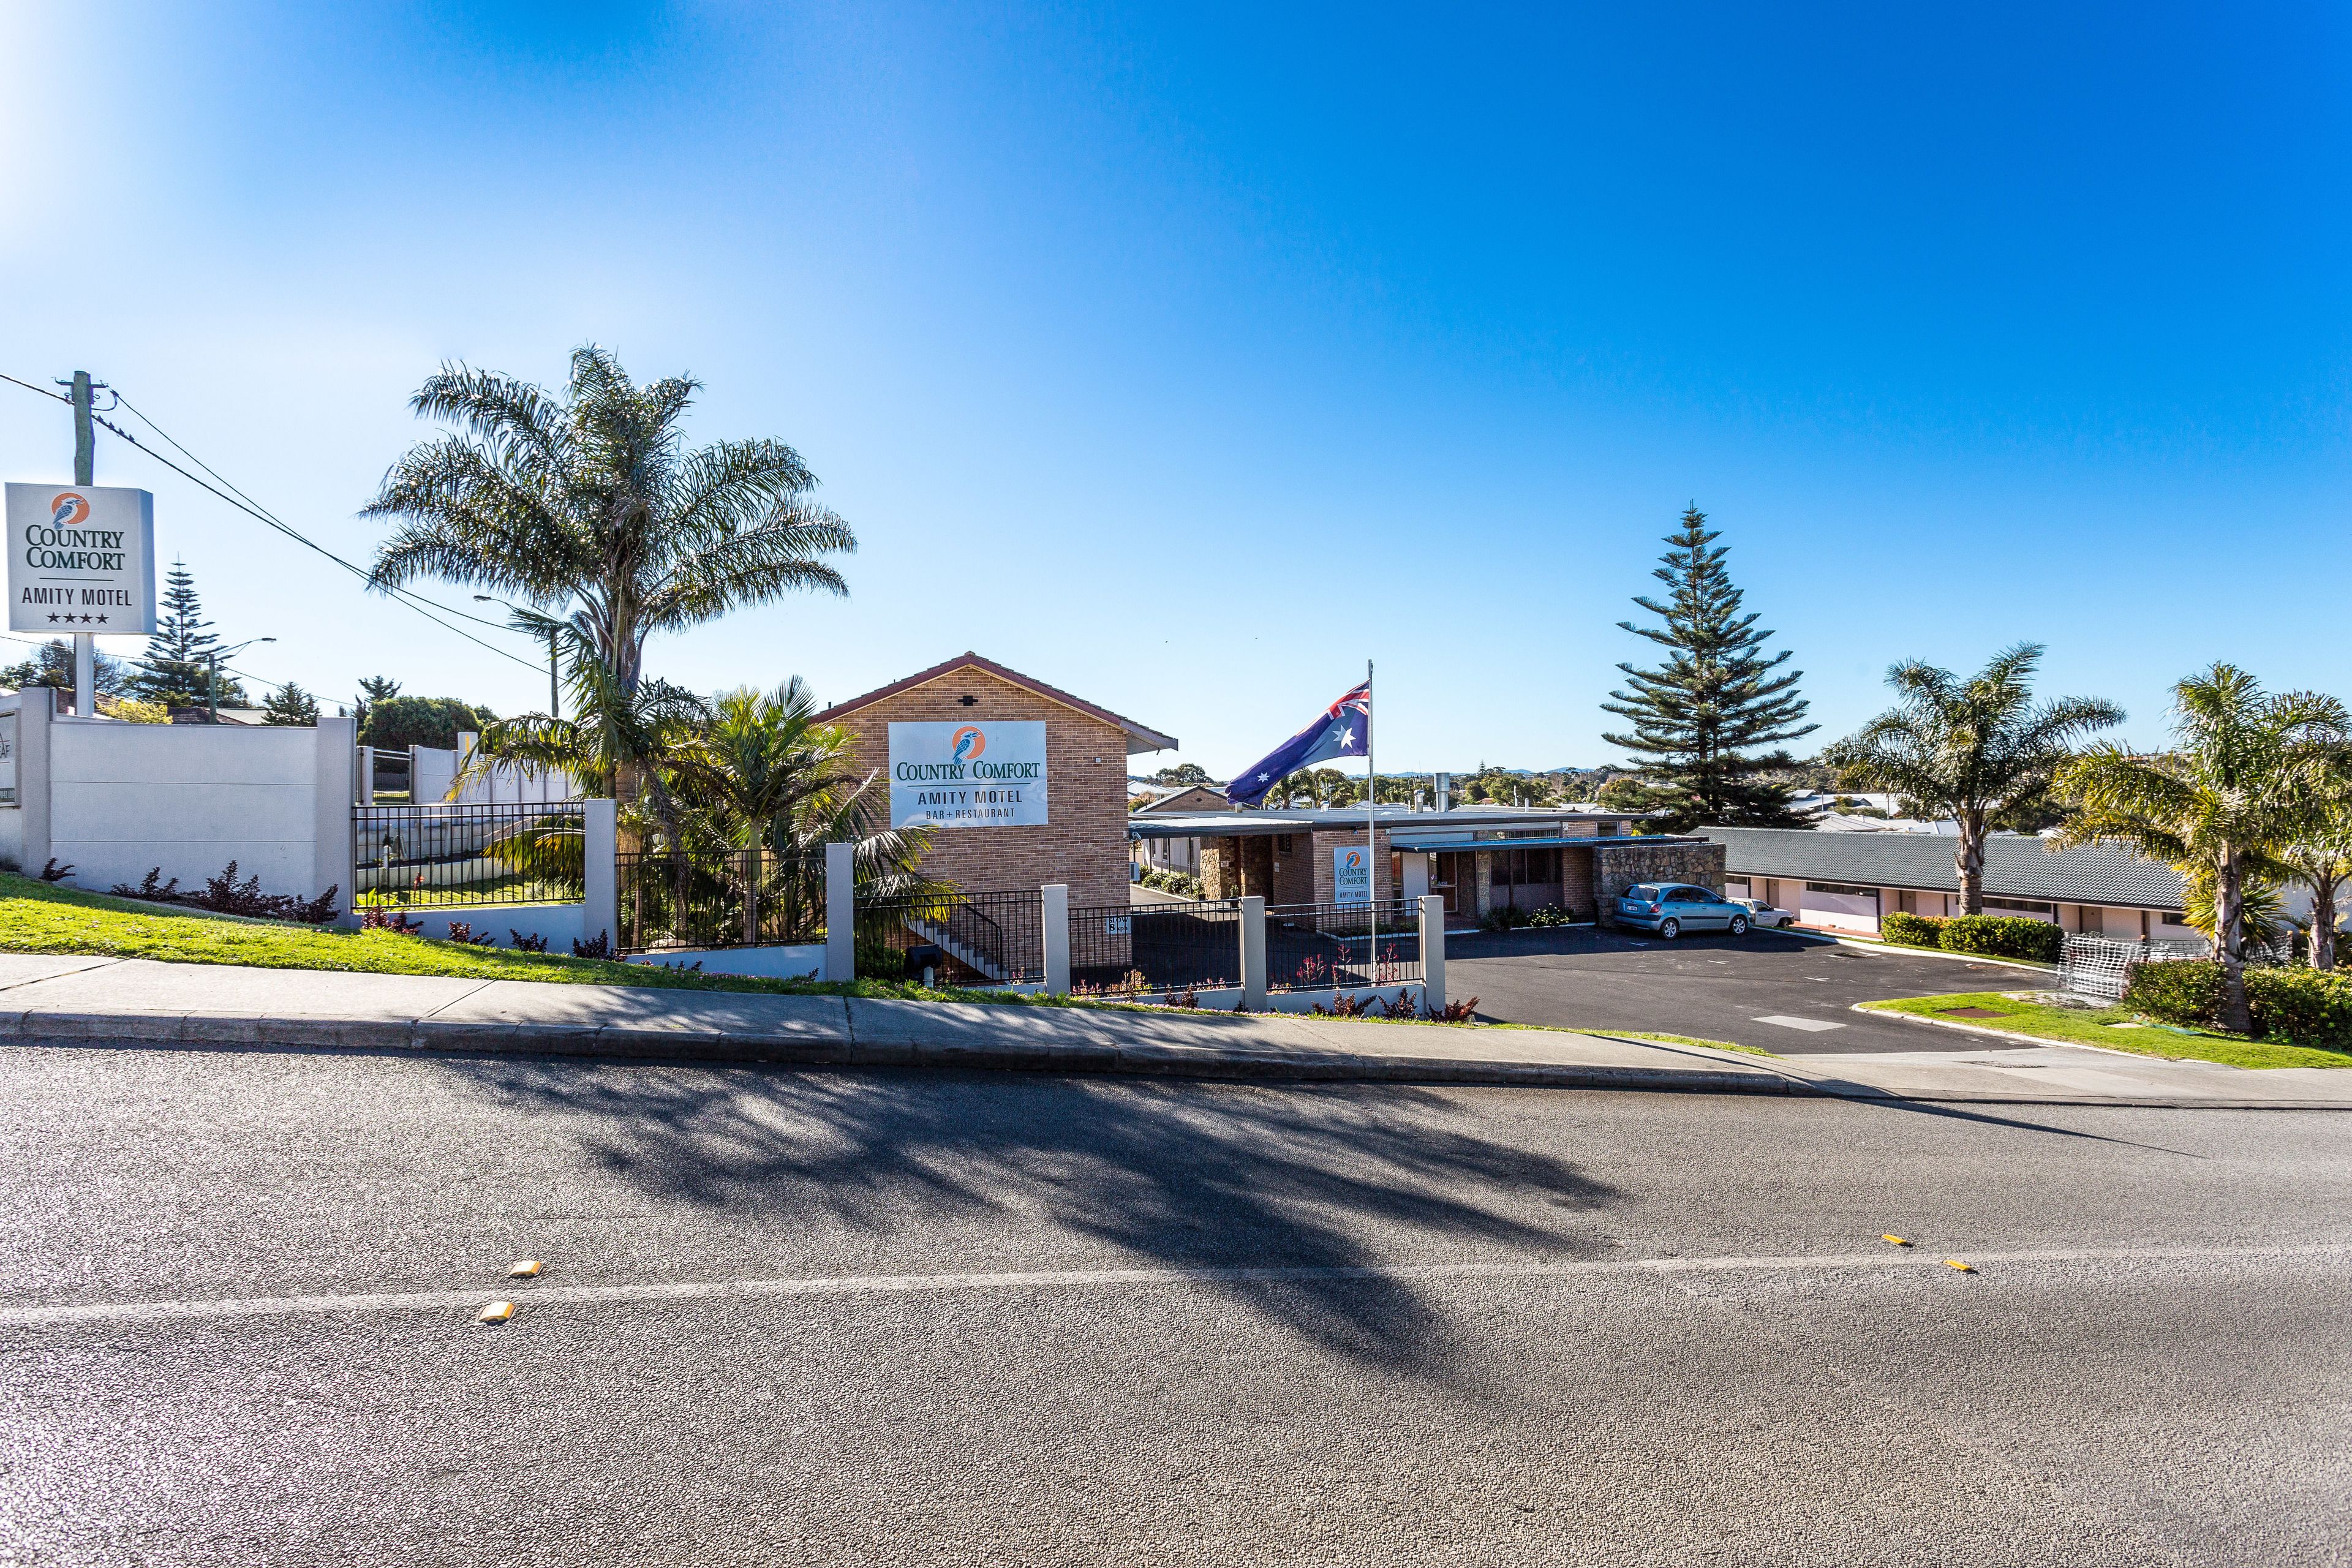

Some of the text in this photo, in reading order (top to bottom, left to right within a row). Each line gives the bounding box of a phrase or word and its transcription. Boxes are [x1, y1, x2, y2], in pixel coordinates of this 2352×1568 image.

[26, 524, 124, 549] COUNTRY
[26, 546, 126, 571] COMFORT
[22, 587, 132, 606] AMITY MOTEL
[897, 760, 1040, 780] COUNTRY COMFORT
[918, 790, 1022, 805] AMITY MOTEL
[1339, 867, 1367, 876] COUNTRY
[1340, 876, 1367, 885] COMFORT
